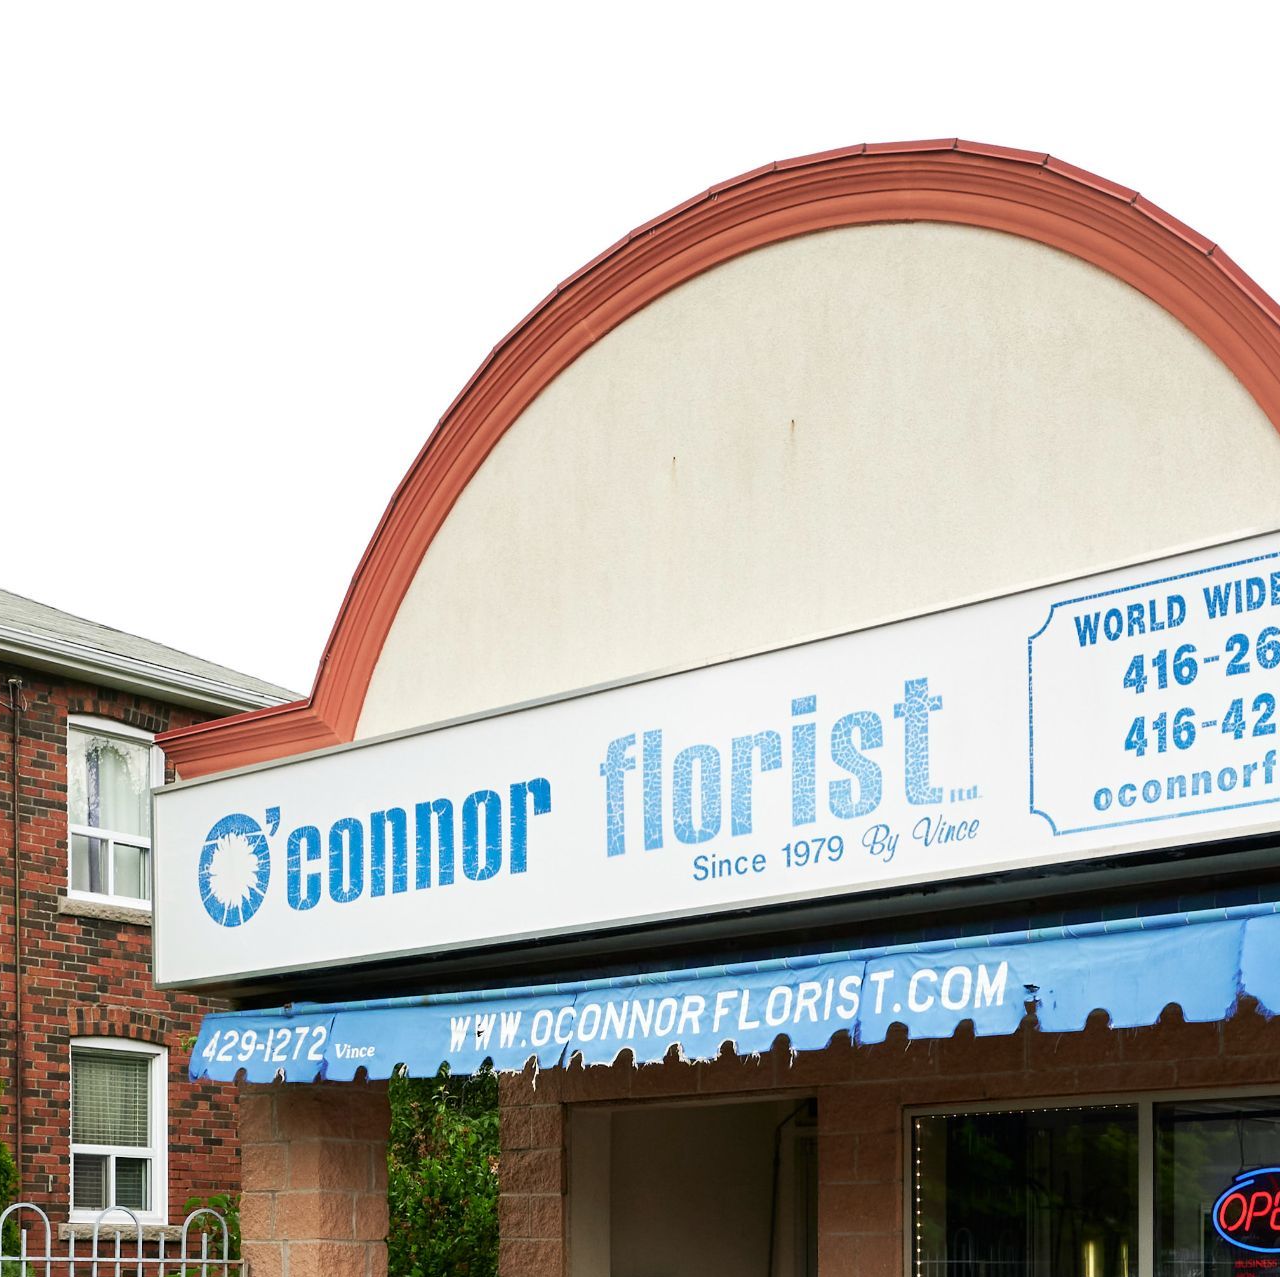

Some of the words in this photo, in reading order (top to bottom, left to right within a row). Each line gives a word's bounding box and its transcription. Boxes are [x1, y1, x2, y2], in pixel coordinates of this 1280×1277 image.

[1073, 594, 1187, 648] WORLD
[198, 777, 552, 928] O'connor
[600, 677, 943, 857] florist
[692, 853, 766, 881] Since
[781, 835, 844, 868] 1979
[862, 823, 899, 863] By
[912, 813, 981, 847] Vince
[202, 1026, 327, 1063] 429-1272
[334, 1043, 376, 1060] Vince
[1235, 1258, 1277, 1269] BUSINESS
